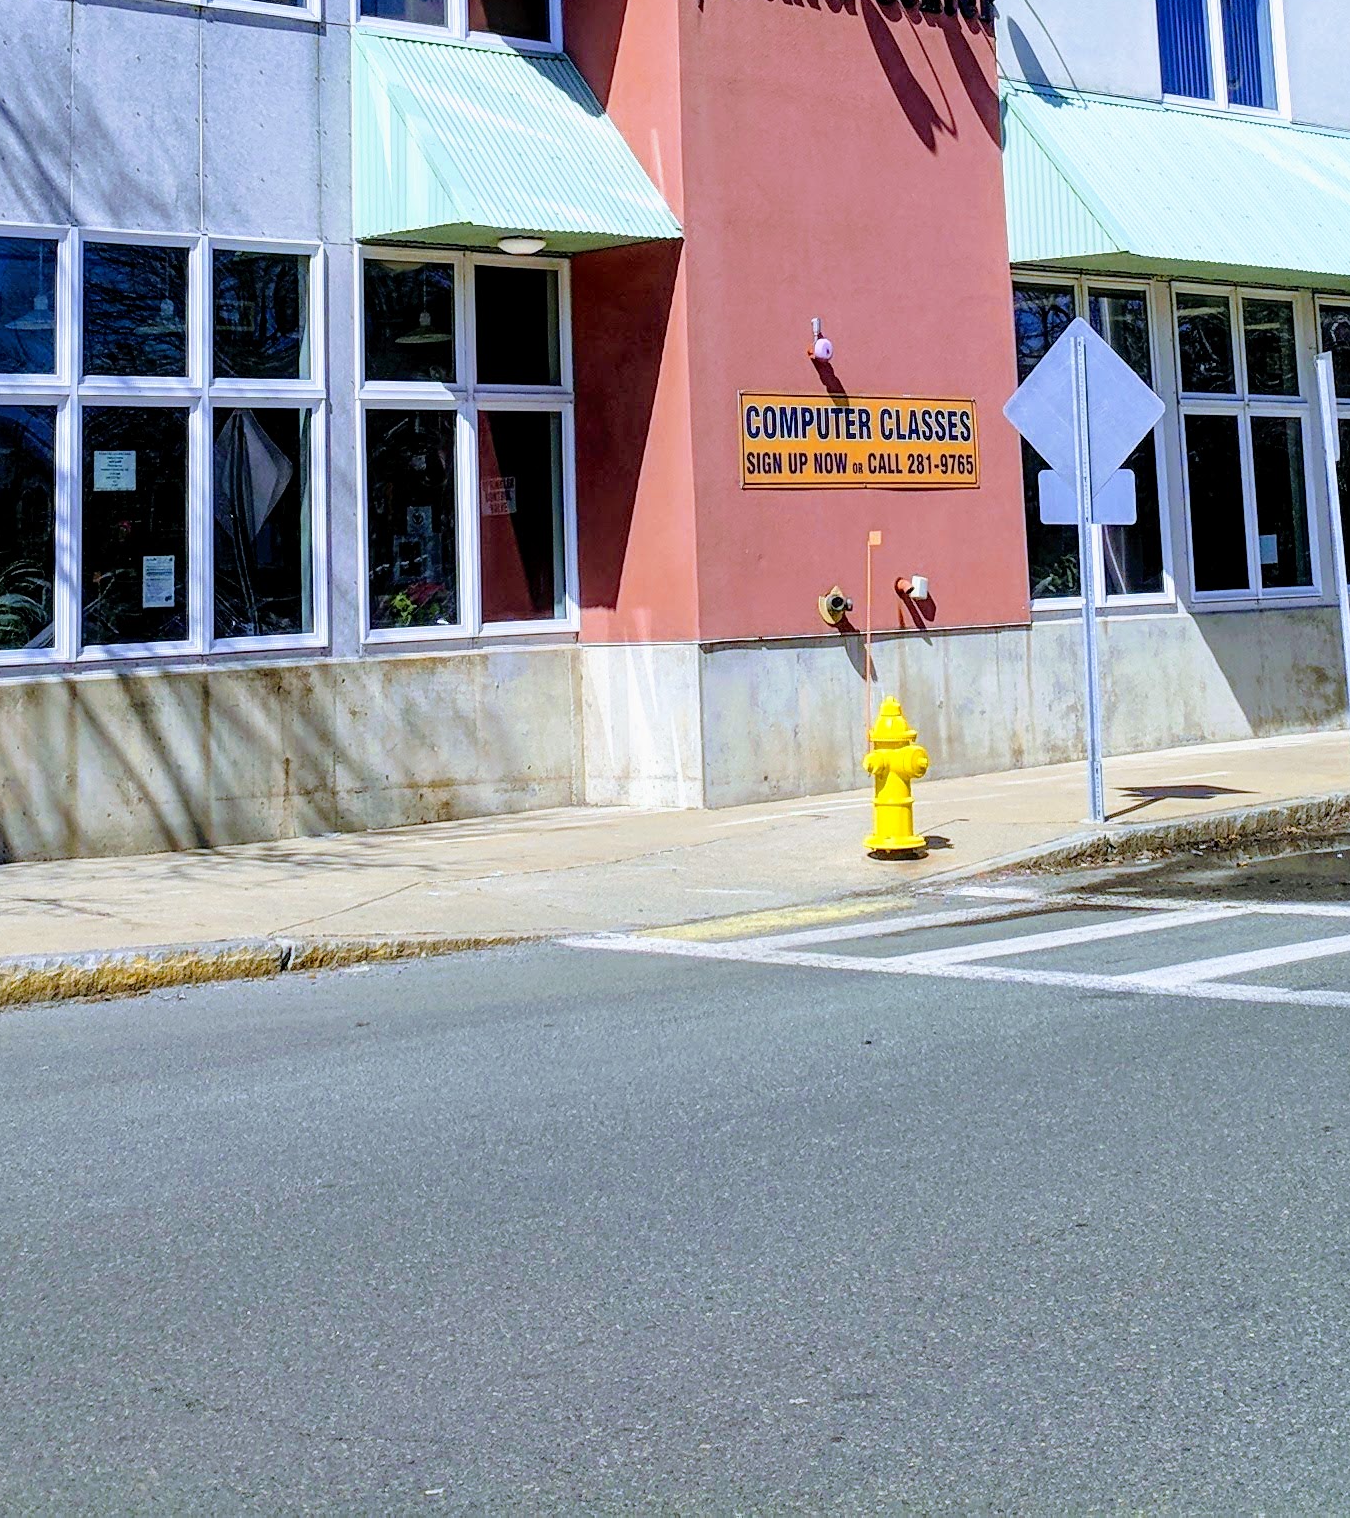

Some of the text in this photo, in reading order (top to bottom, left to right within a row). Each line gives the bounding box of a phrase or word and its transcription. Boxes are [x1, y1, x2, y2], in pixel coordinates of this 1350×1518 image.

[746, 405, 971, 442] COMPUTER CLASSES
[746, 451, 782, 475] SIGN
[788, 452, 808, 475] UP
[814, 452, 848, 475] NOW
[868, 453, 903, 475] CALL
[907, 453, 974, 475] 281-9765
